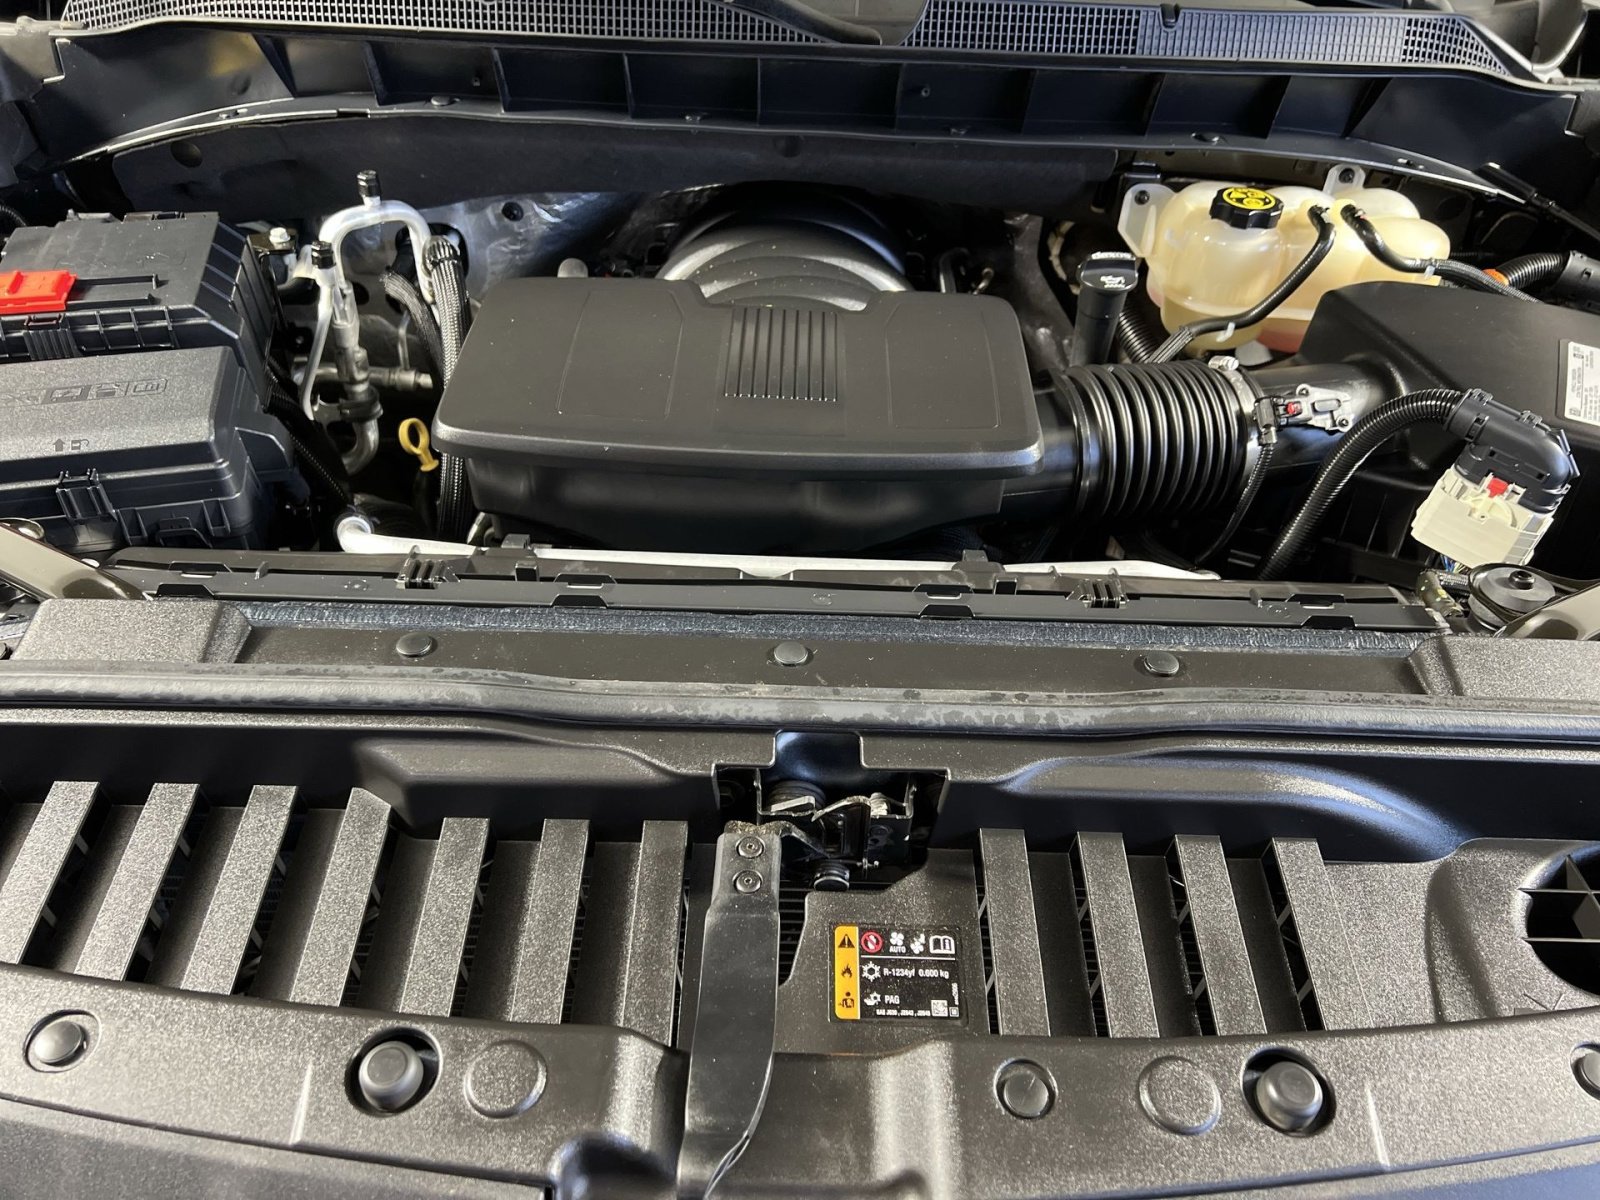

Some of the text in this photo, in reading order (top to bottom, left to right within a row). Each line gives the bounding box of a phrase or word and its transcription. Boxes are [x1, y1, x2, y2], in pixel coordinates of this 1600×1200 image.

[883, 967, 950, 980] R-1234yf 0.600 kg
[884, 995, 900, 1004] PAG
